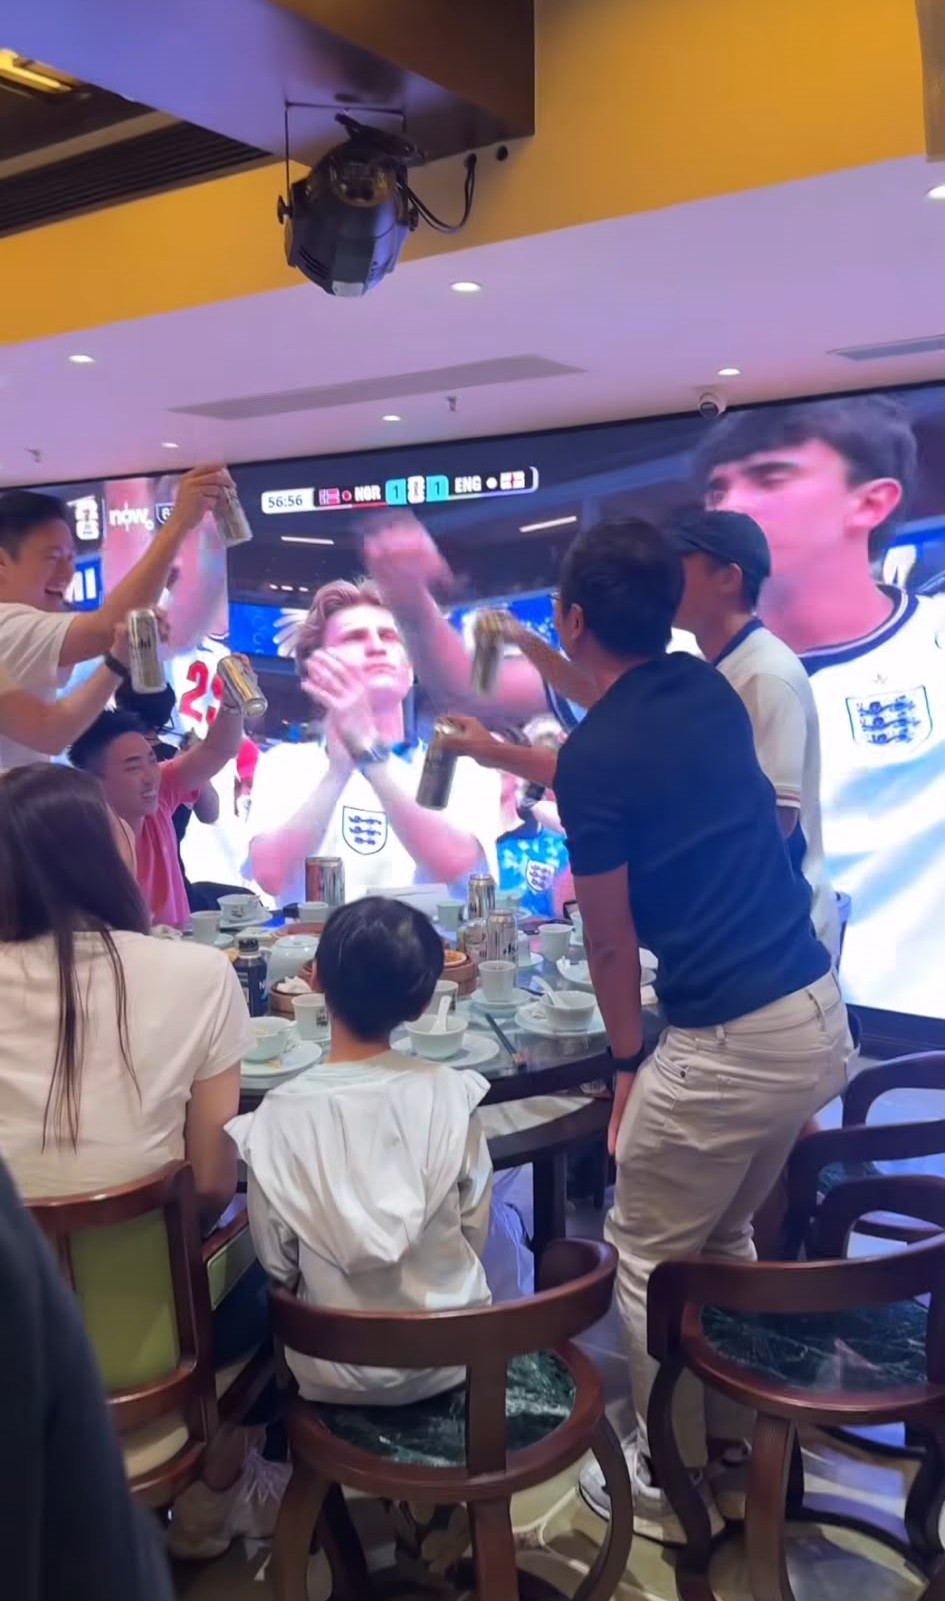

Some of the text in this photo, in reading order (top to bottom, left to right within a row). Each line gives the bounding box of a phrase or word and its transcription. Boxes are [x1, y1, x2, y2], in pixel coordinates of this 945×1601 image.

[268, 494, 303, 508] 56:56
[354, 485, 381, 502] NOR
[392, 485, 399, 499] 1
[454, 475, 482, 493] ENG
